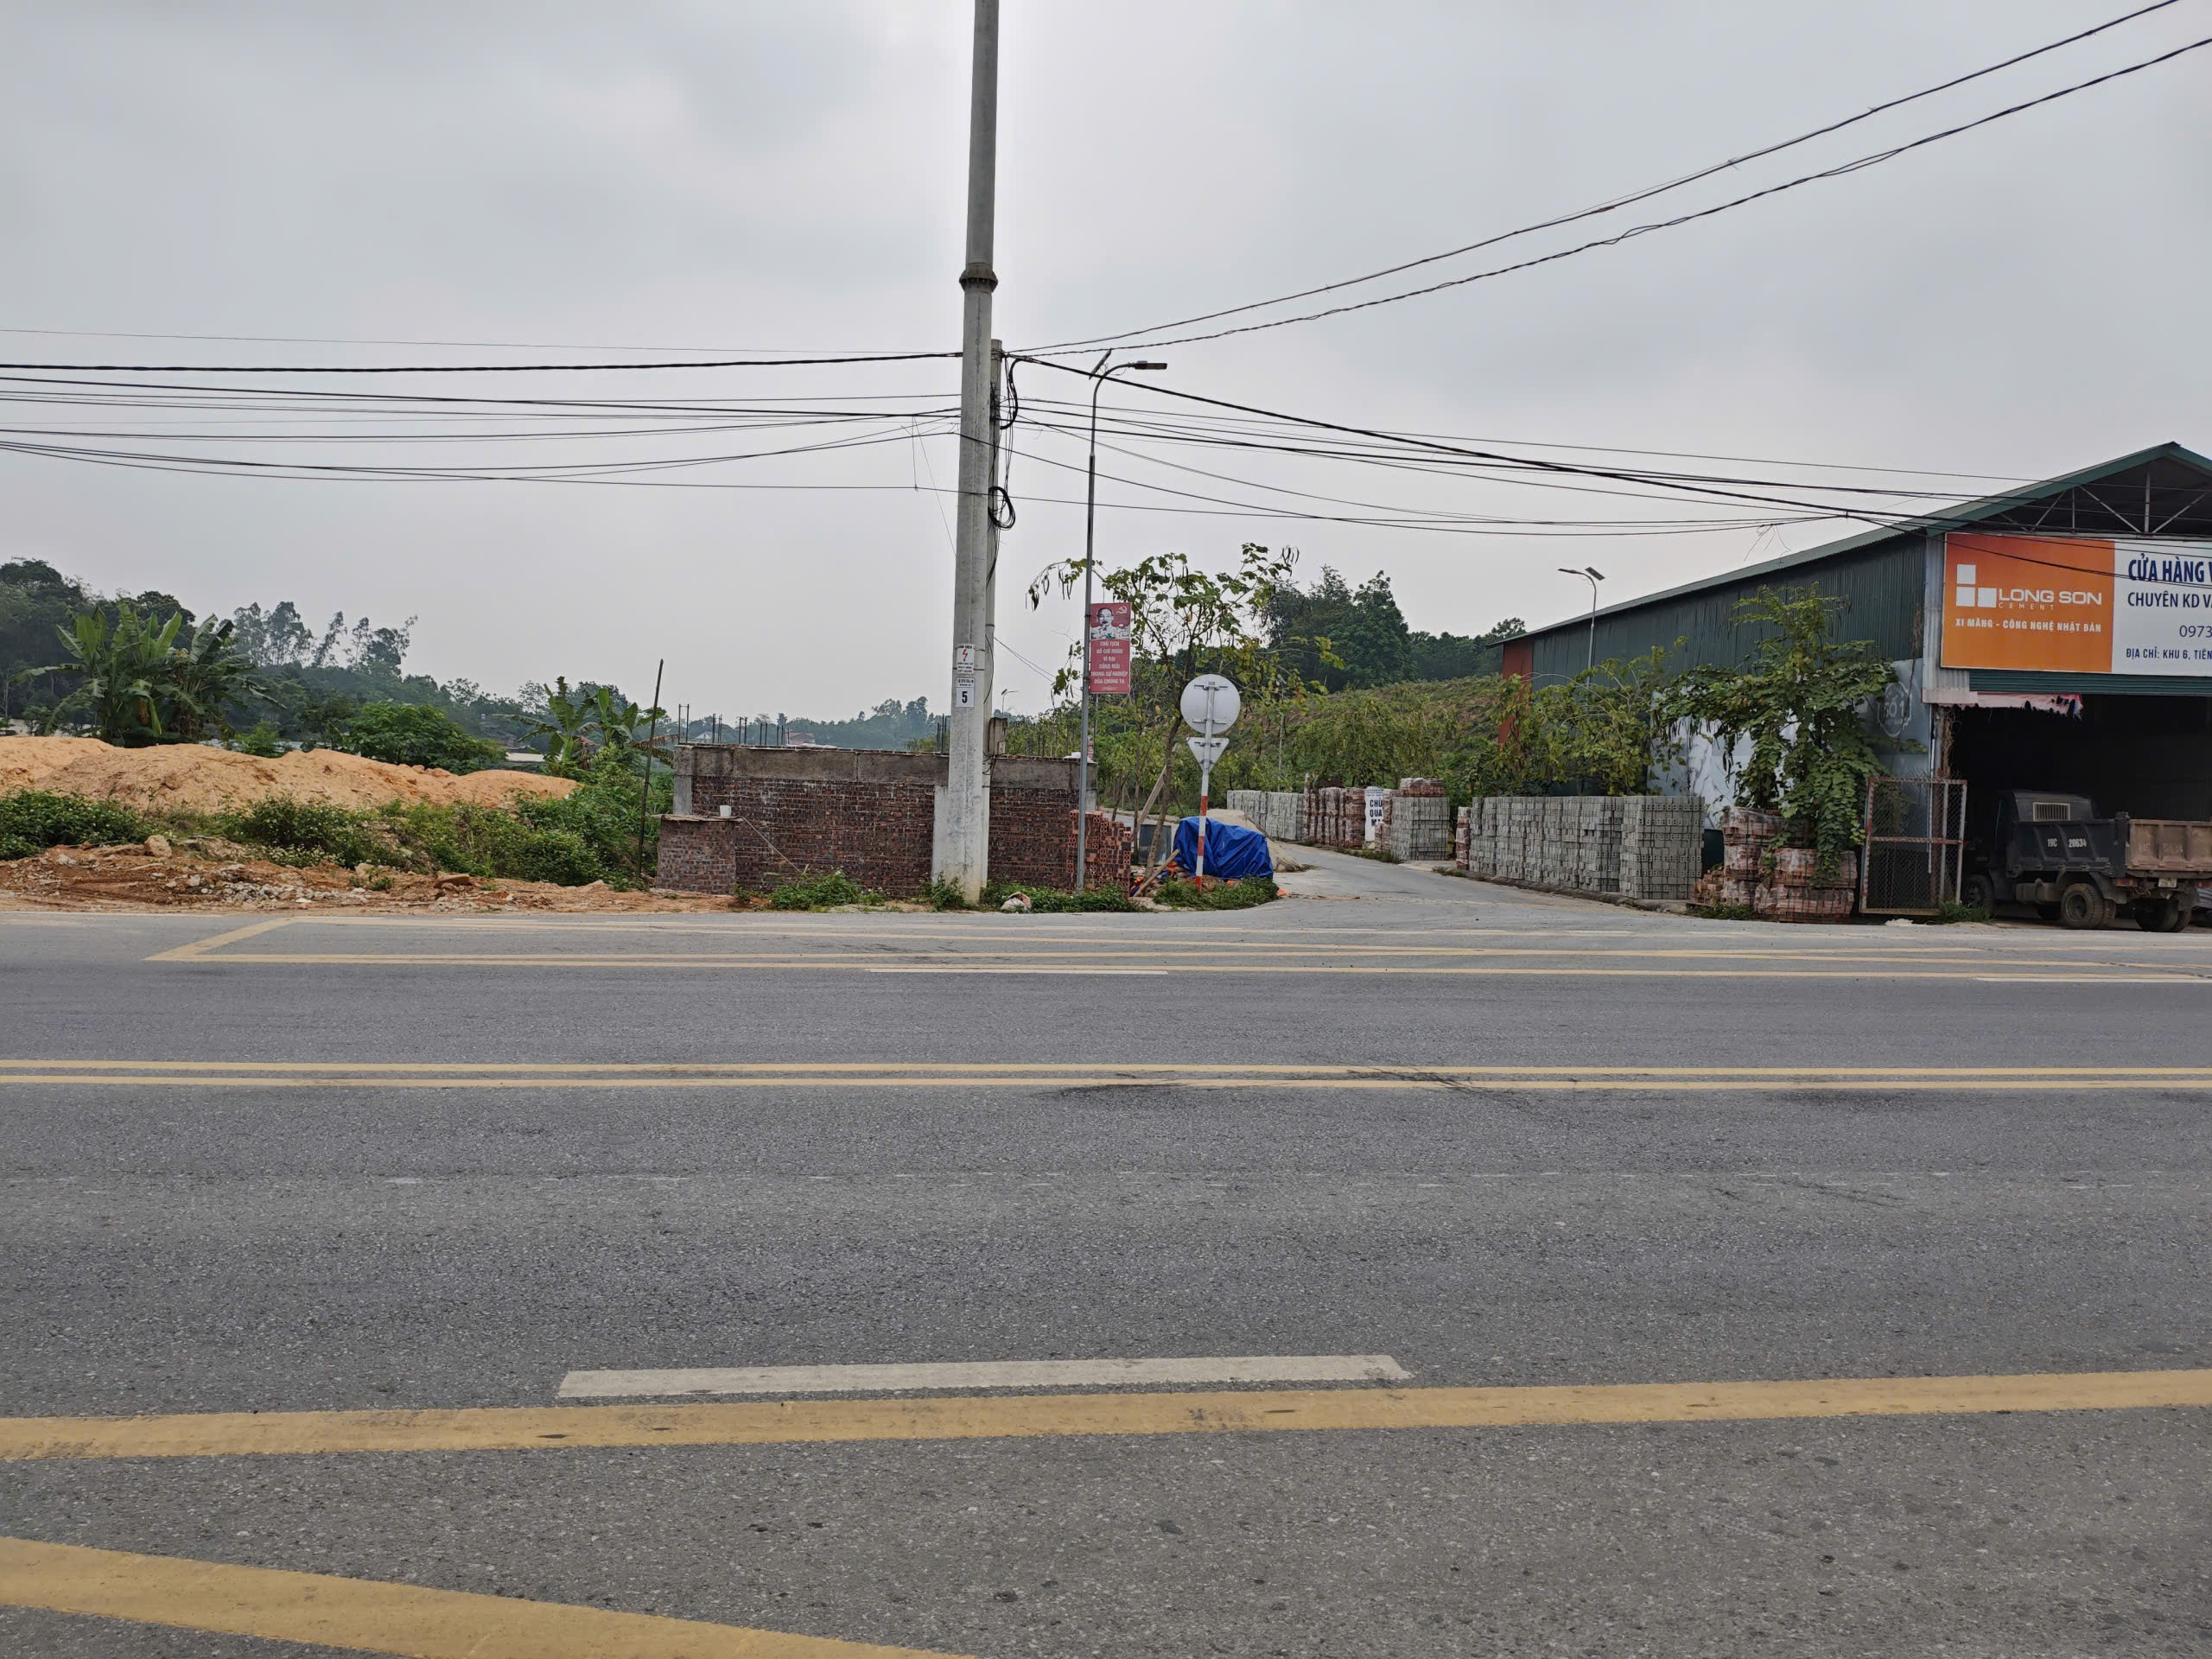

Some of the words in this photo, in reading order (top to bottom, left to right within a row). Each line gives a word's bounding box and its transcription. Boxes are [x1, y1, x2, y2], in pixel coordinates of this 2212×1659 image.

[2128, 553, 2158, 581] CỬA
[2162, 556, 2205, 582] HÀNG
[1999, 588, 2054, 603] LONG
[2059, 591, 2101, 605] SON
[2127, 590, 2178, 607] CHUYÊN
[2183, 594, 2200, 608] KD
[1955, 618, 1964, 627] XI
[2002, 619, 2027, 630] CÔNG
[2030, 620, 2054, 632] NGHỆ
[2056, 621, 2081, 633] NHẬT
[2126, 648, 2140, 660] ĐỊA
[2143, 645, 2160, 659] CHỈ:
[2163, 649, 2180, 659] KHU
[962, 690, 968, 703] 5
